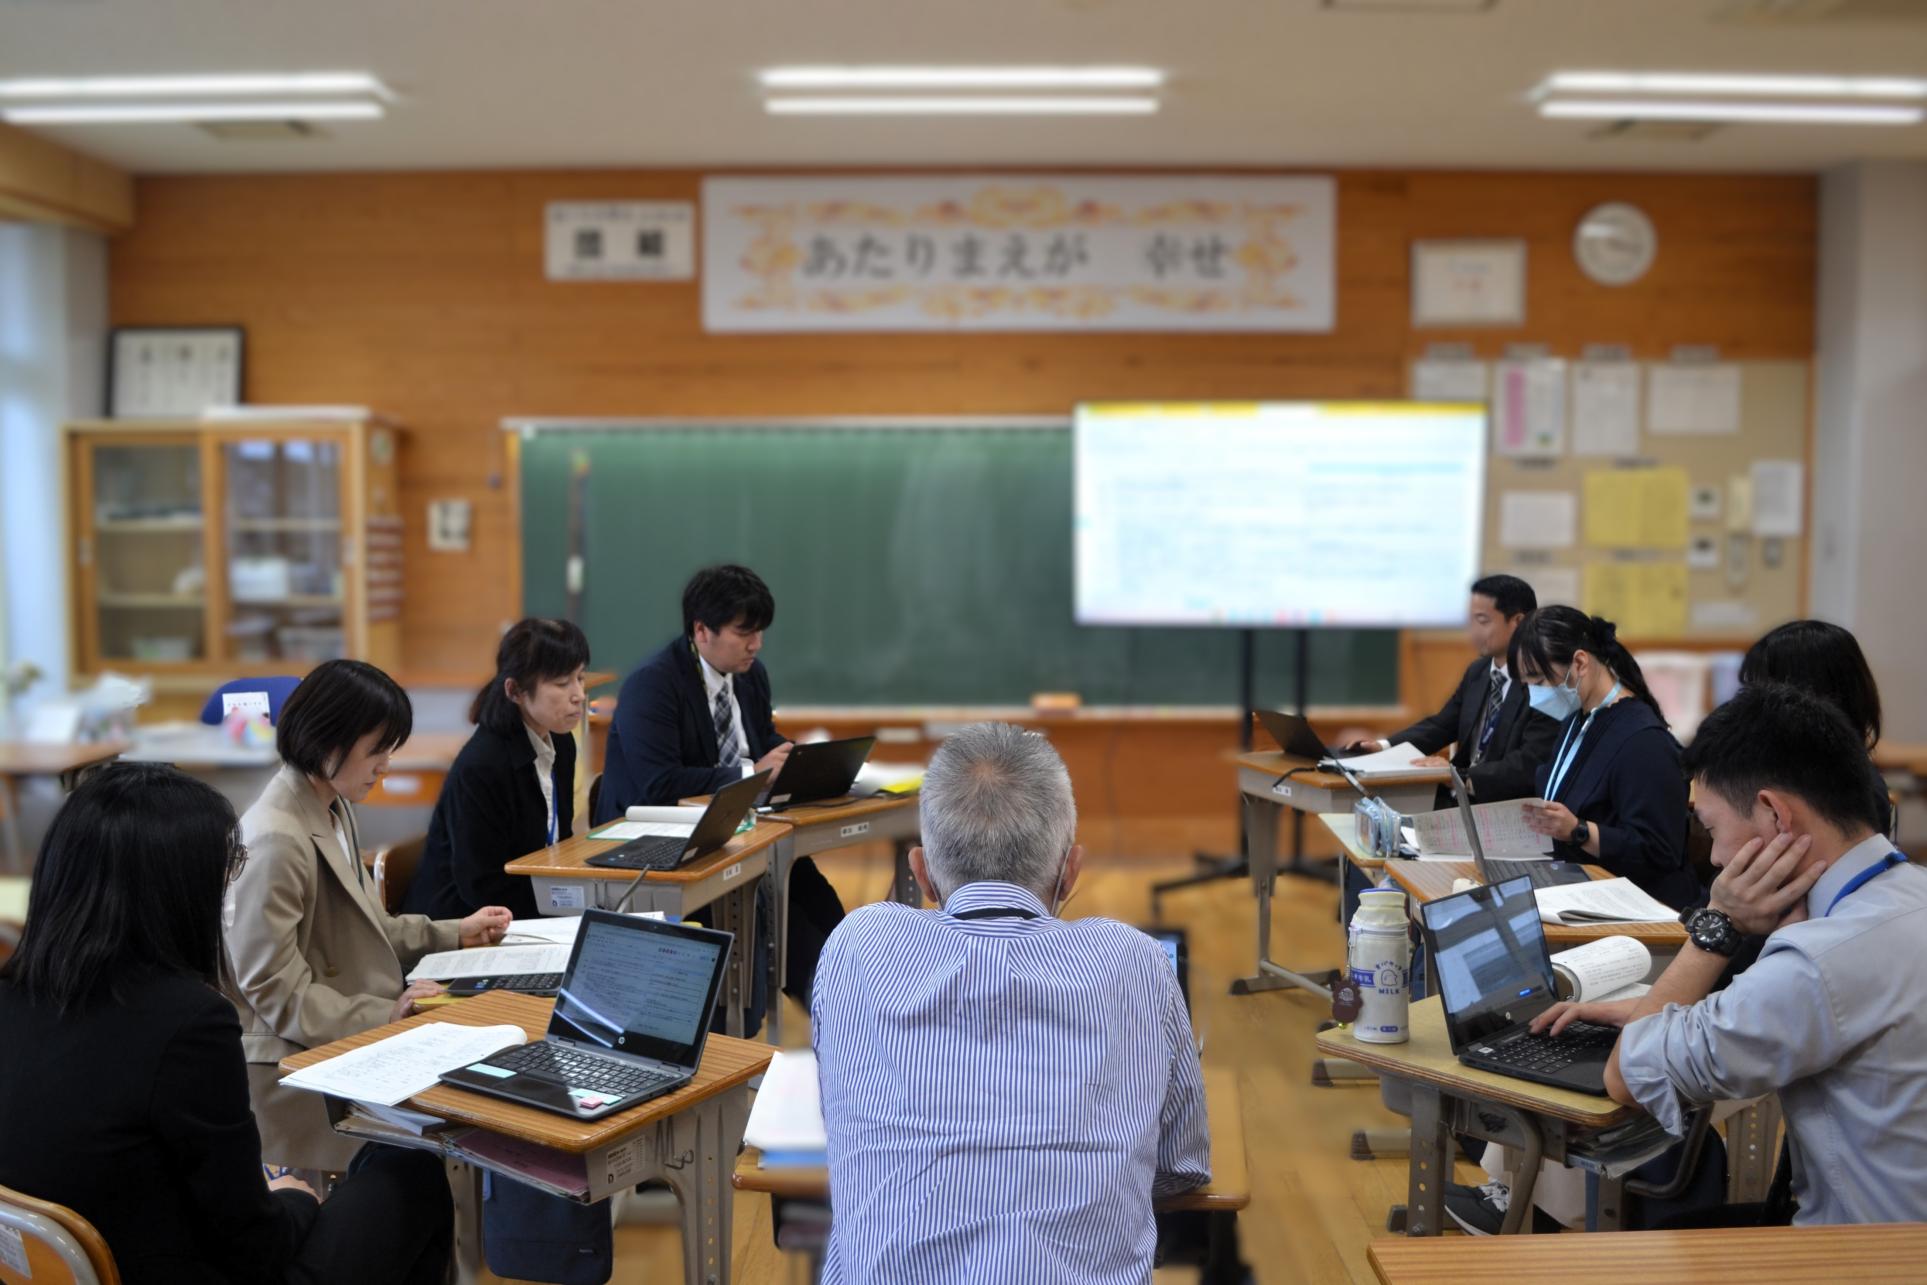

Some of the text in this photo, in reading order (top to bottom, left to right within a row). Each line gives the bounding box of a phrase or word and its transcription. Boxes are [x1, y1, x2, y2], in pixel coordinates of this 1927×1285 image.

[803, 233, 1089, 279] あたりまえが
